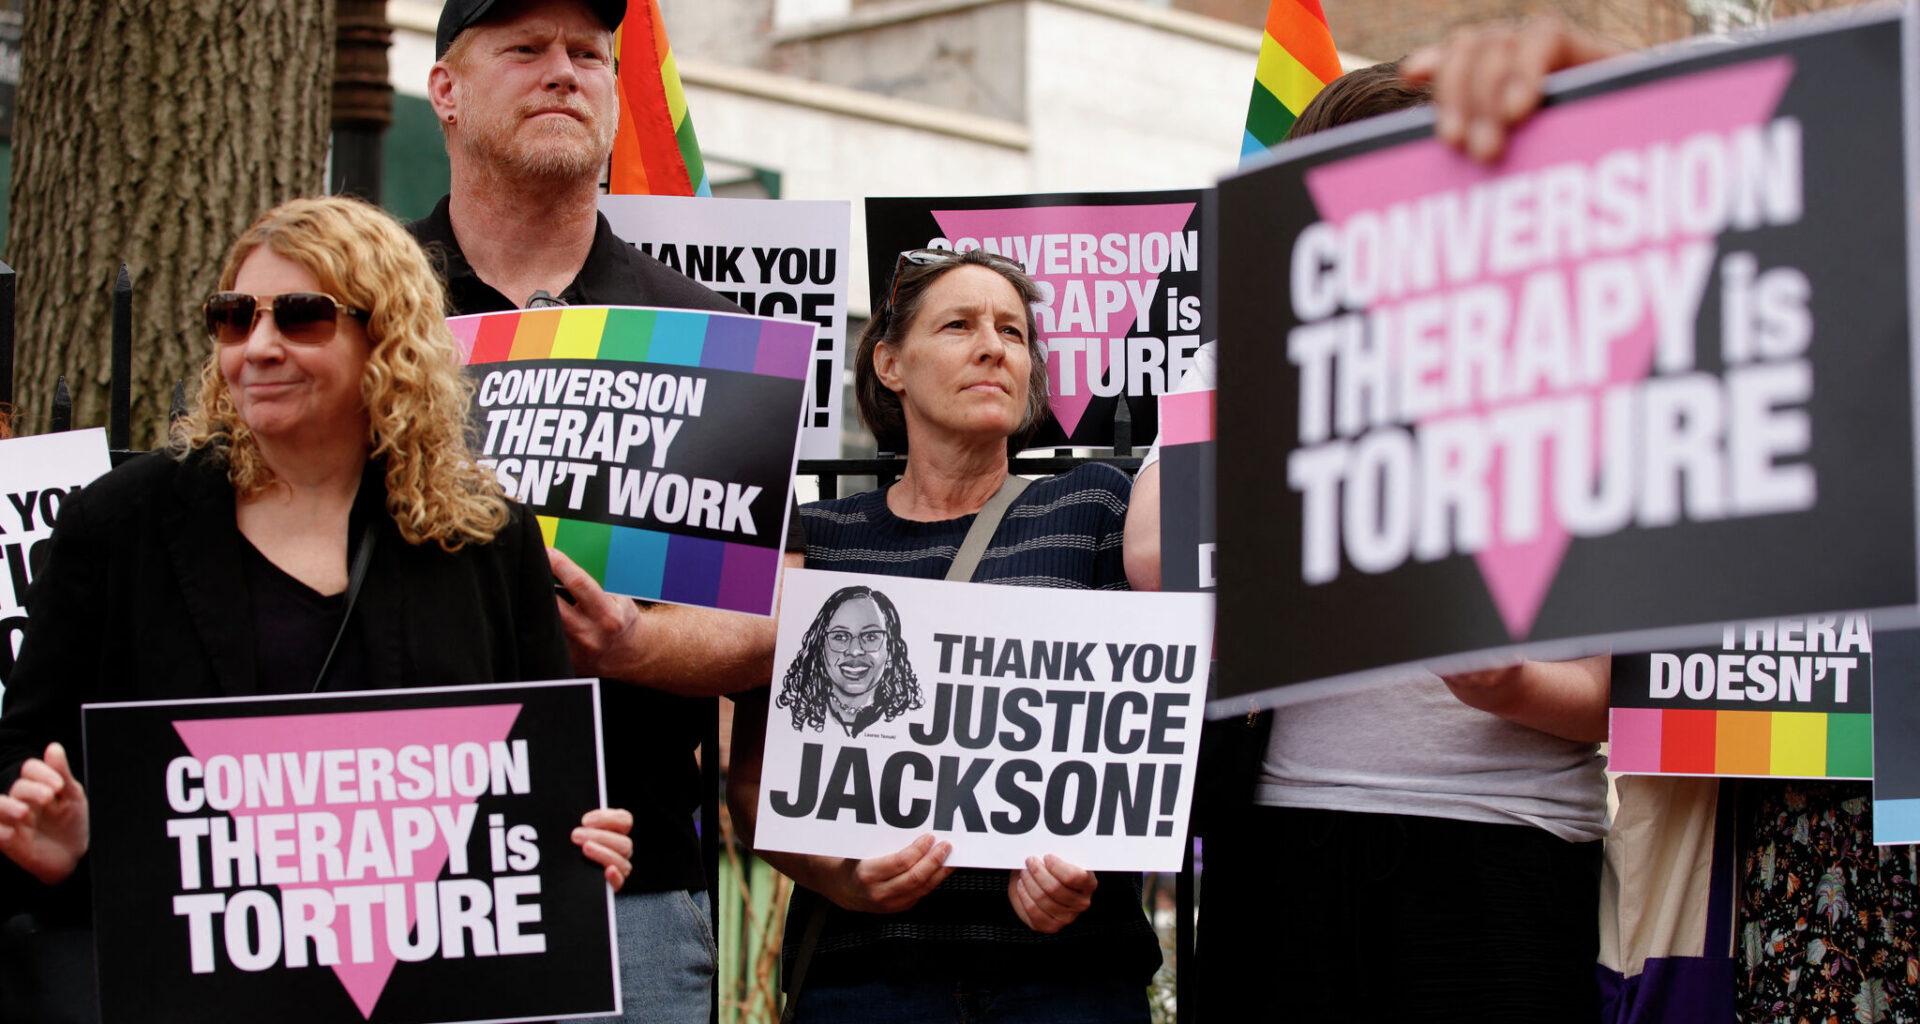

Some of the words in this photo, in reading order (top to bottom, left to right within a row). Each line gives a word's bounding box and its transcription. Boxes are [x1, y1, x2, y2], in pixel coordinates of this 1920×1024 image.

[1288, 117, 1803, 321] CONVERSION
[626, 242, 746, 284] ANK
[751, 246, 837, 286] YOU
[926, 230, 1199, 275] NVERSION
[1031, 278, 1161, 334] RAPY
[1167, 287, 1202, 332] is
[1043, 334, 1201, 397] TURE
[1287, 236, 1717, 444] THERAPY
[1721, 252, 1813, 364] is
[478, 368, 708, 417] CONVERSION
[482, 408, 683, 469] THERAPY
[475, 457, 599, 511] SN'T
[608, 466, 763, 537] WORK
[1287, 360, 1815, 585] TORTURE
[6, 484, 81, 532] YO
[933, 632, 1099, 682] THANK
[1106, 642, 1197, 685] YOU
[1722, 613, 1873, 653] HERA
[1649, 652, 1858, 704] DOESN'T
[908, 682, 1192, 755] JUSTICE
[165, 739, 531, 813] CONVERSION
[769, 742, 1183, 838] JACKSON!
[166, 803, 479, 890] THERAPY
[488, 813, 540, 873] is
[172, 874, 547, 974] TORTURE
